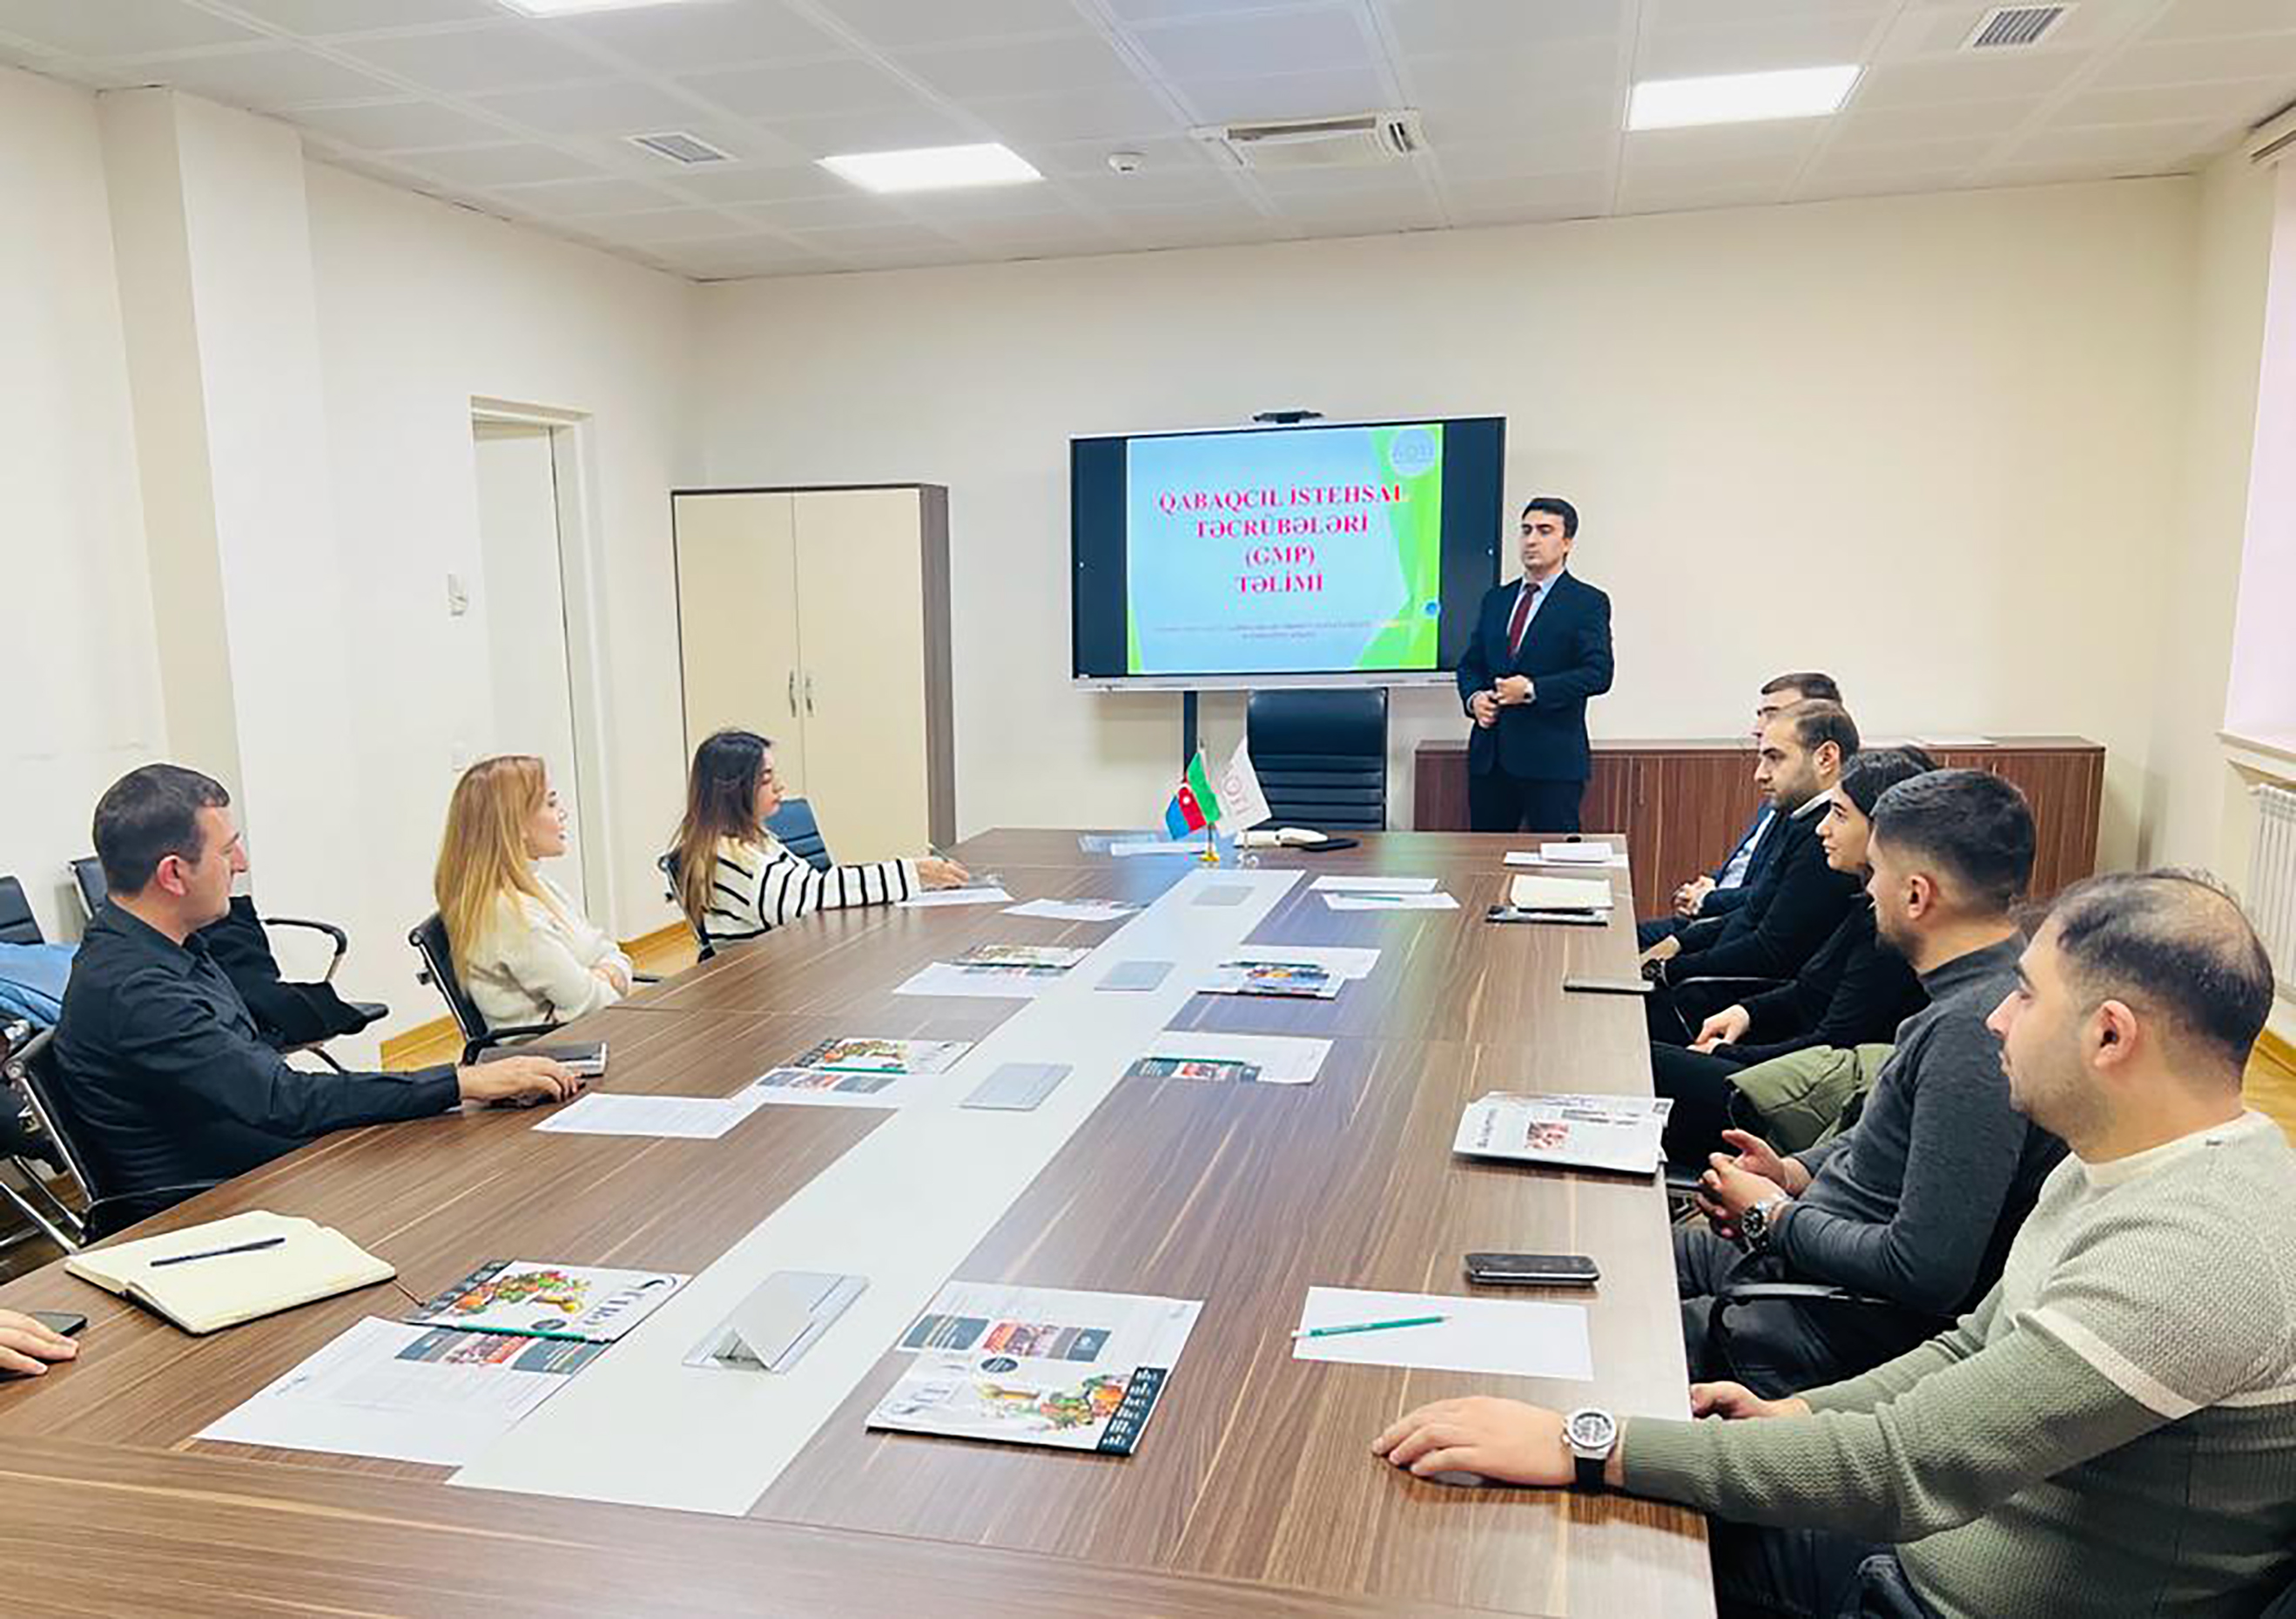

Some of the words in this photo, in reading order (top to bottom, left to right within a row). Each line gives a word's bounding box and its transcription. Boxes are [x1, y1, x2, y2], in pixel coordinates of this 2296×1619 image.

[1159, 489, 1283, 515] QABAQCIL
[1192, 510, 1368, 539] TƏCRÜBƏLƏRİ
[1245, 546, 1315, 569] (GMP)
